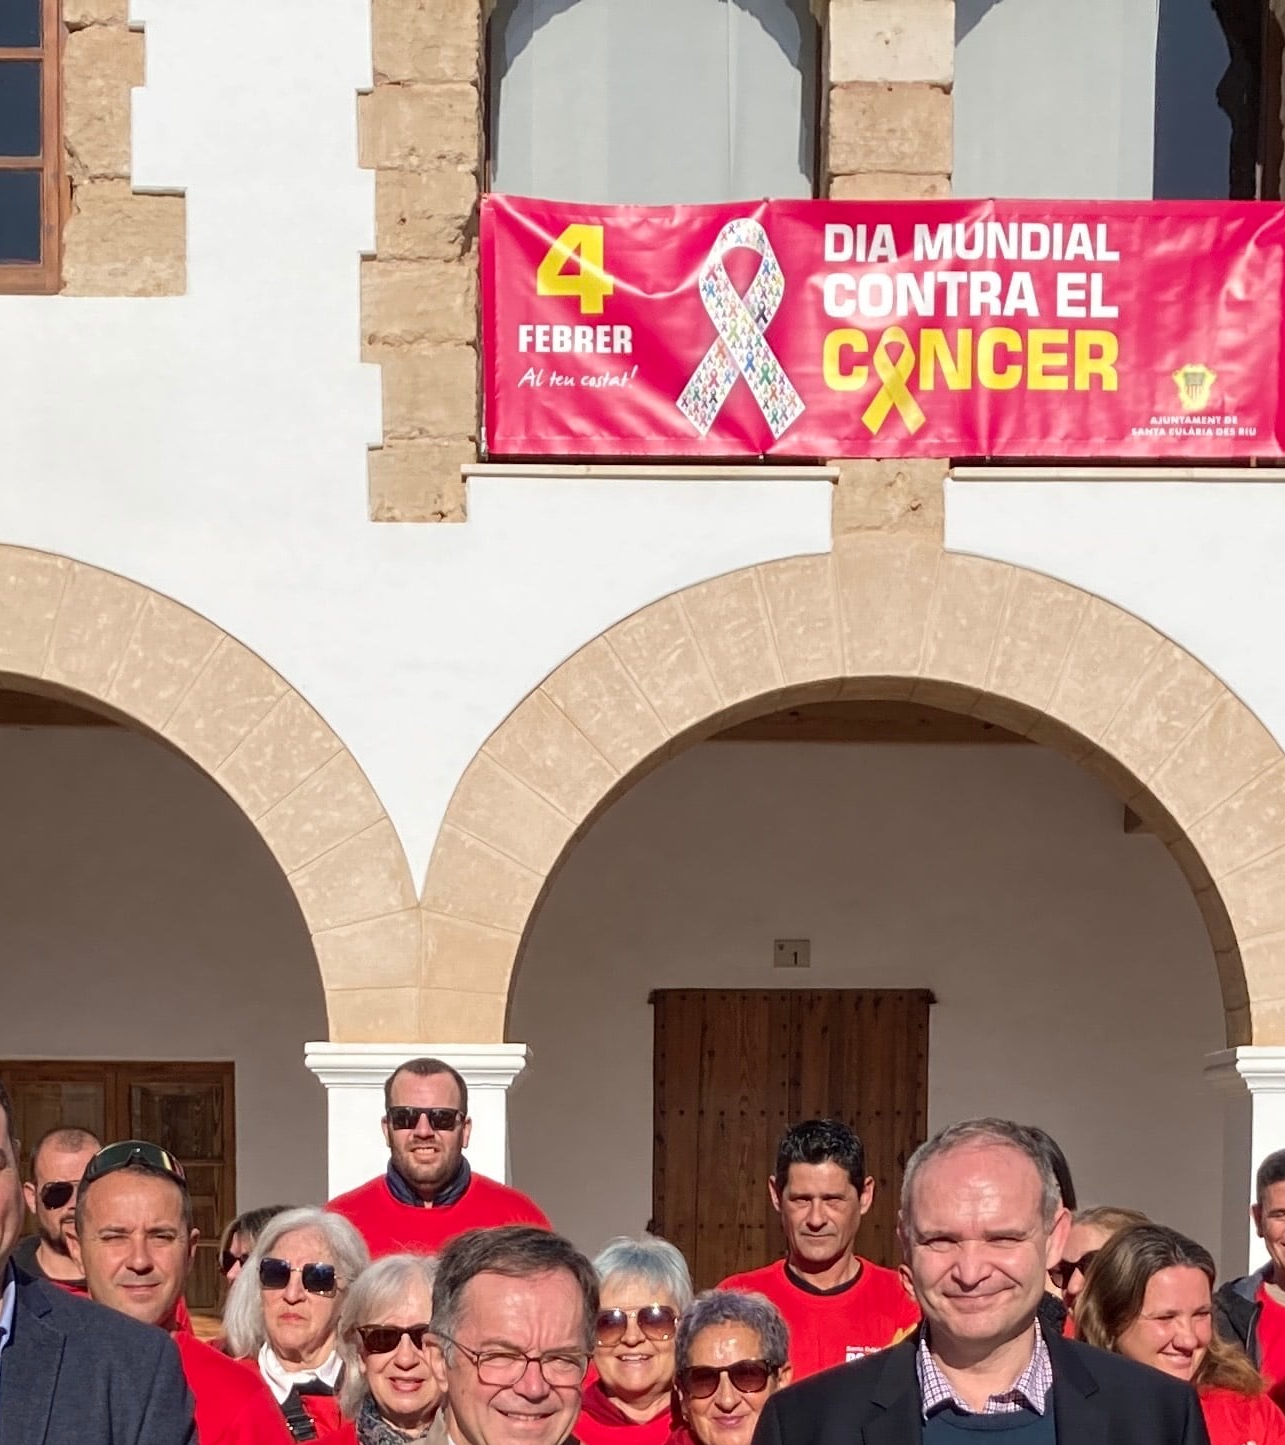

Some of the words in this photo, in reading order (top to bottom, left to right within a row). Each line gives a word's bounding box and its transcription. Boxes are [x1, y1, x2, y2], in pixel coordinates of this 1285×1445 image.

[823, 222, 899, 263] DIA
[913, 221, 1120, 262] MUNDIAL
[537, 223, 615, 315] 4
[822, 271, 1040, 318] CONTRA
[1055, 272, 1119, 318] EL
[518, 324, 634, 354] FEBRER
[517, 366, 545, 389] Al
[549, 371, 576, 388] teu
[580, 364, 640, 389] costat!
[1131, 427, 1166, 436] SANTA
[1215, 427, 1236, 437] DES
[1238, 427, 1257, 437] RIU
[1149, 415, 1222, 425] AJUNTAMENT
[1224, 415, 1238, 425] DE
